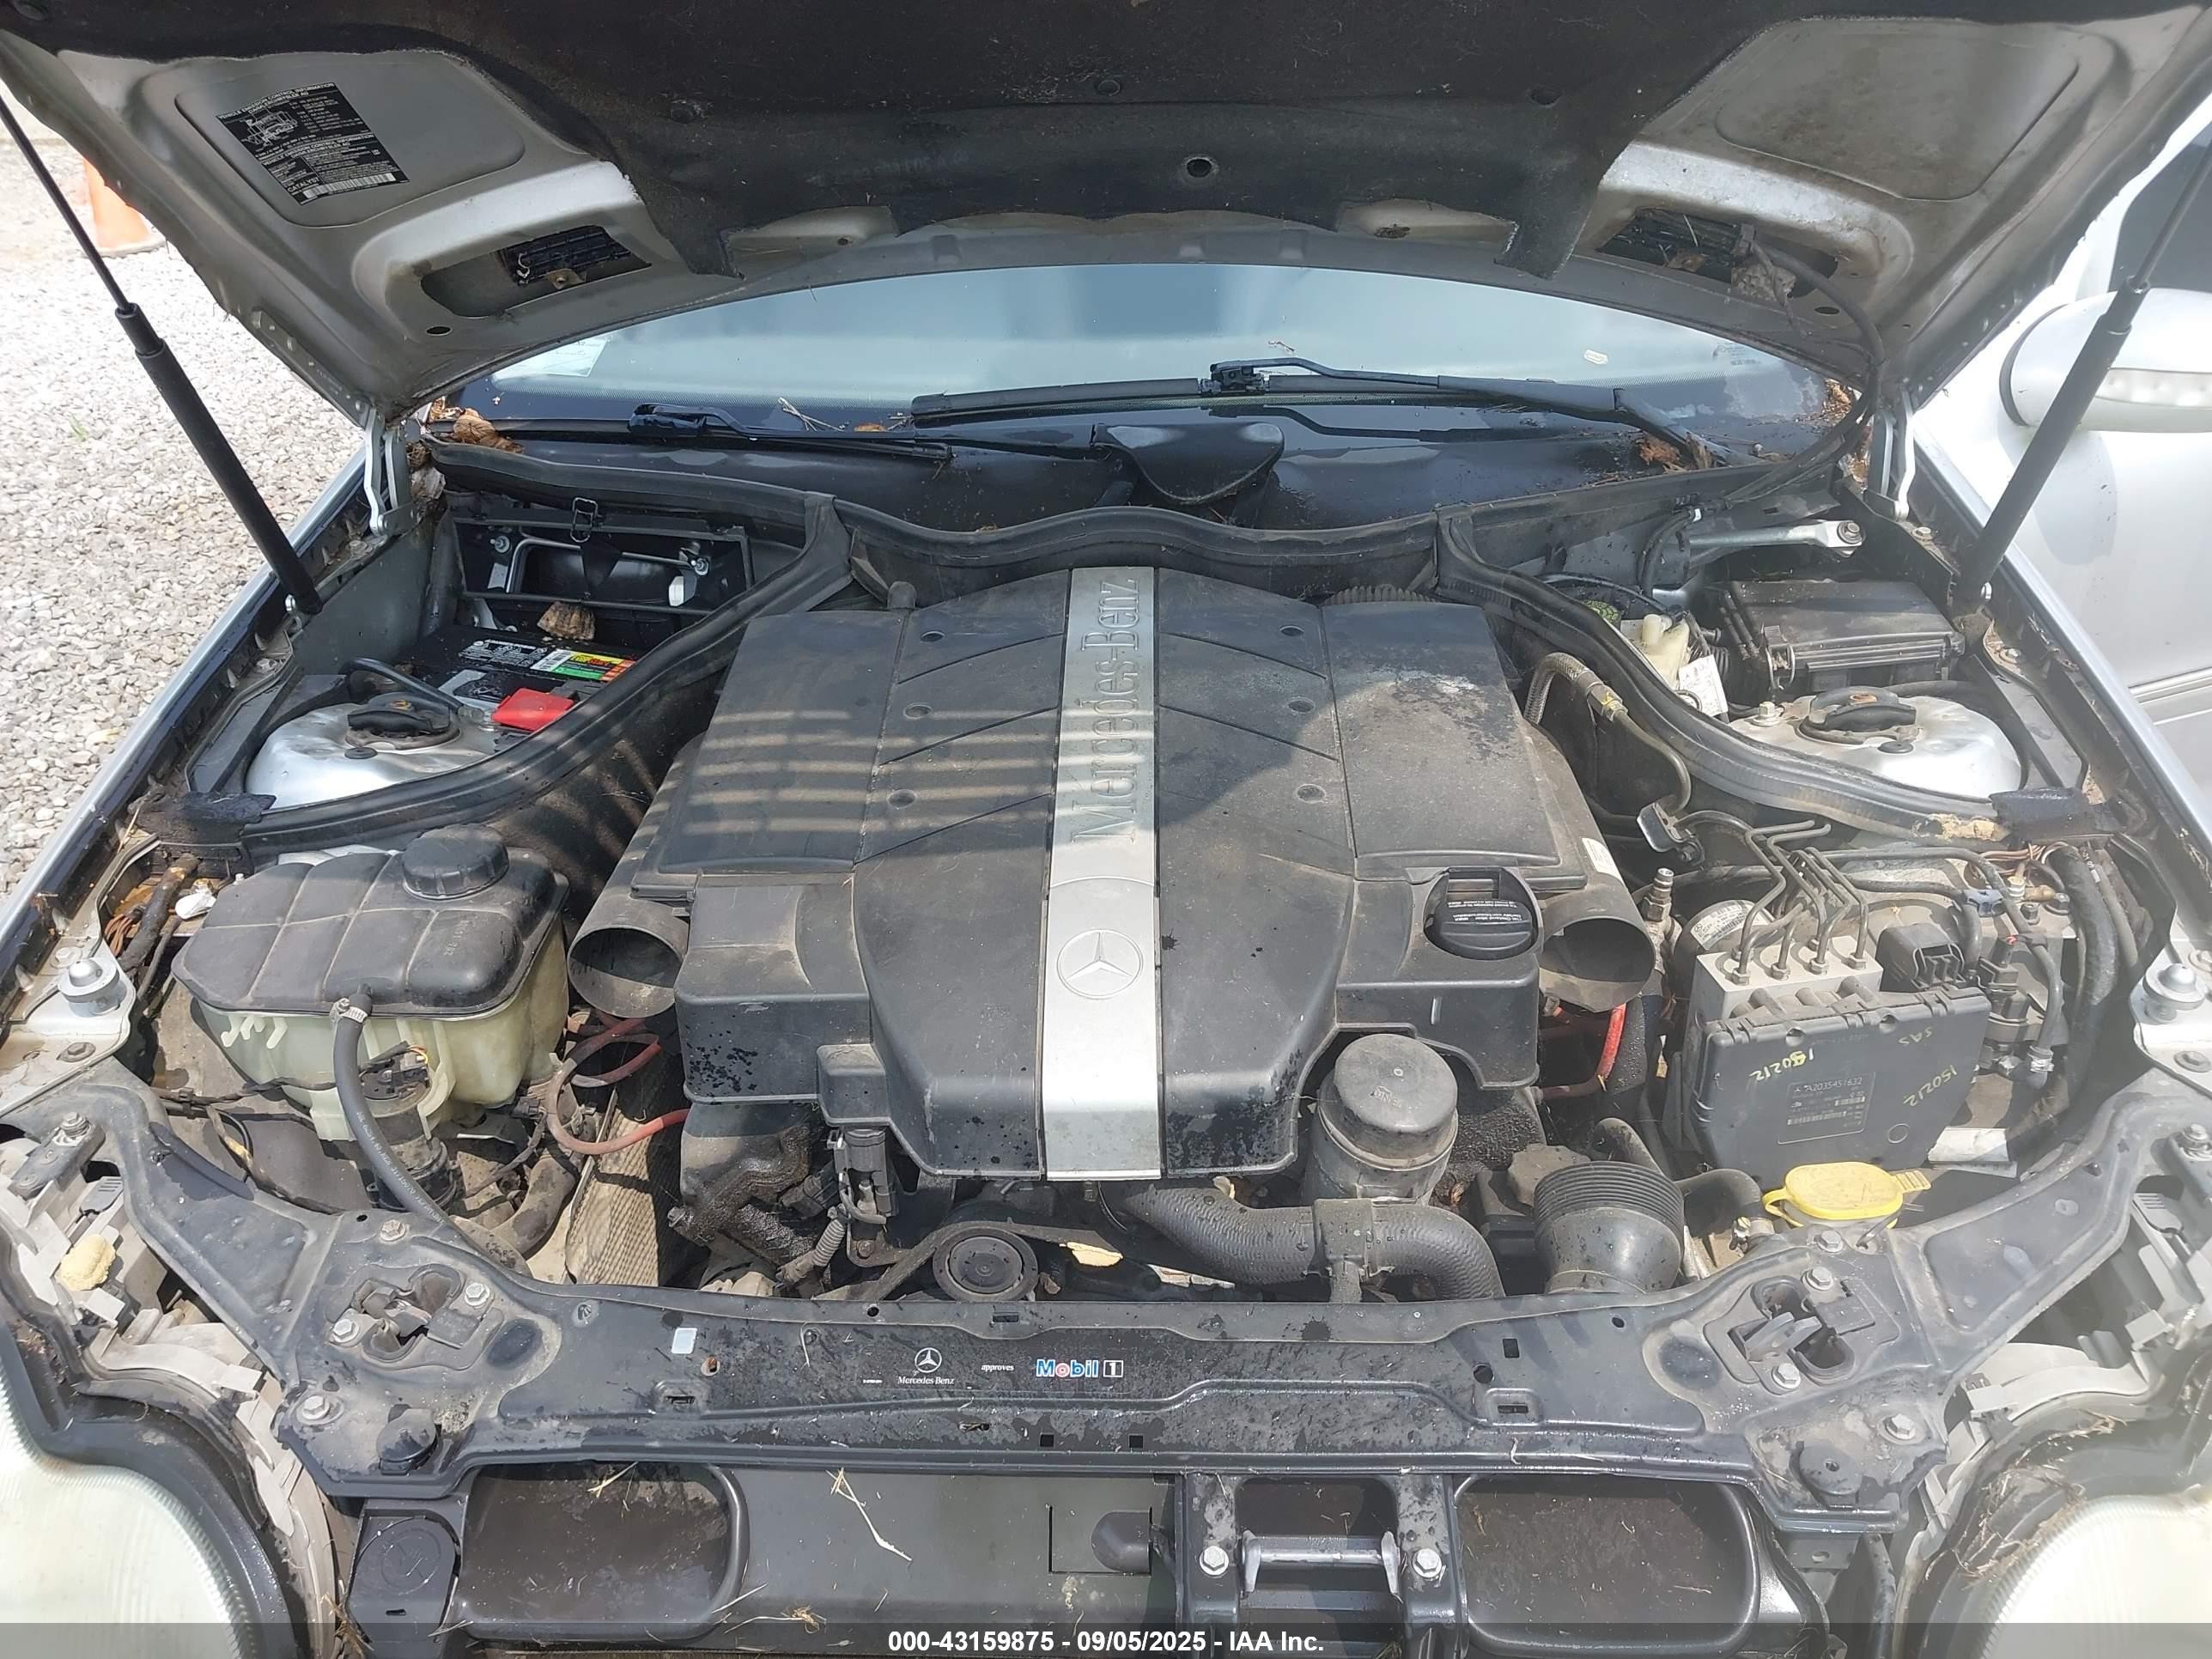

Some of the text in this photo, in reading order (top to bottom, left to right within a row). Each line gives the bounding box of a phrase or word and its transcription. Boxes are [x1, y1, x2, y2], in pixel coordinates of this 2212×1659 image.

[287, 177, 319, 192] CATALYST
[1071, 578, 1139, 843] Mercedes-Benz
[981, 1364, 1015, 1373] approves
[1036, 1358, 1099, 1378] Mobil
